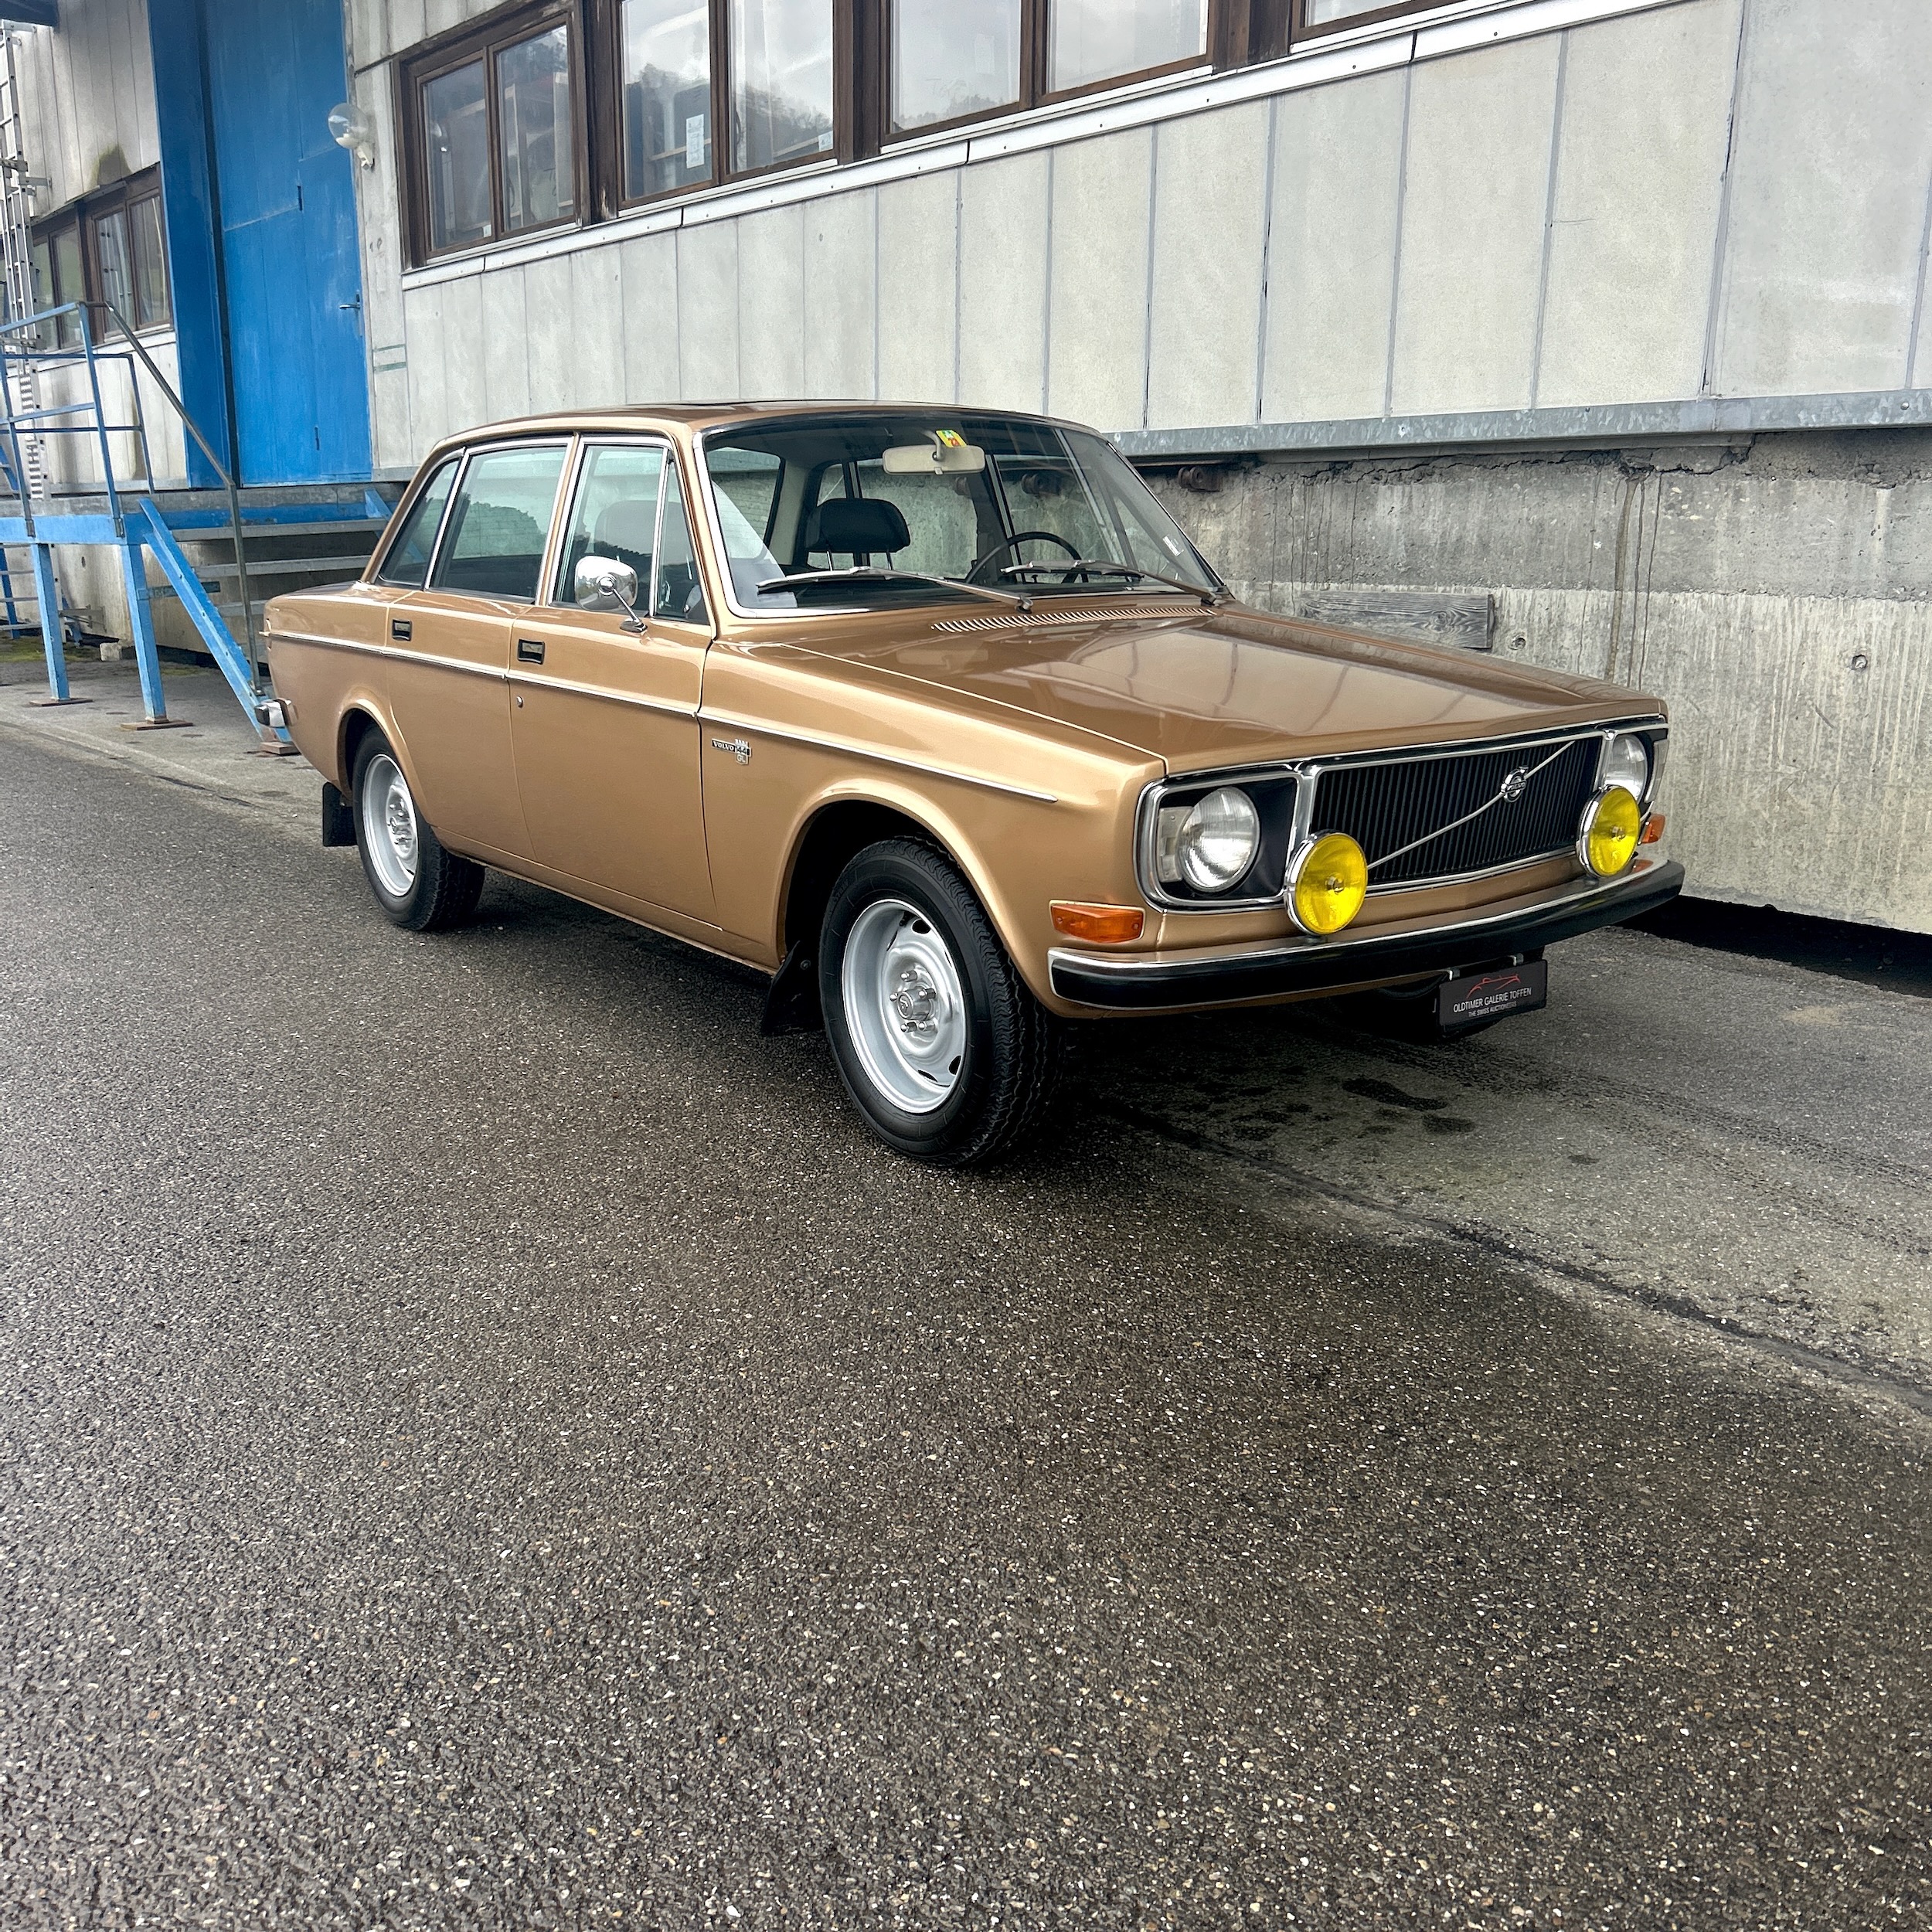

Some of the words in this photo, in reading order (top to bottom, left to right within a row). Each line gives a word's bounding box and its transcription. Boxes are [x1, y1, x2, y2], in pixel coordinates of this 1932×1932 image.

[713, 740, 734, 751] VOLVO
[736, 754, 746, 763] GL
[1453, 998, 1484, 1013] OLDTIMER
[1484, 992, 1509, 1006] GALERIE
[1509, 987, 1532, 1000] TOFFEN
[1477, 1007, 1490, 1016] SWISS
[1490, 1001, 1517, 1013] AUCTIONEERS
